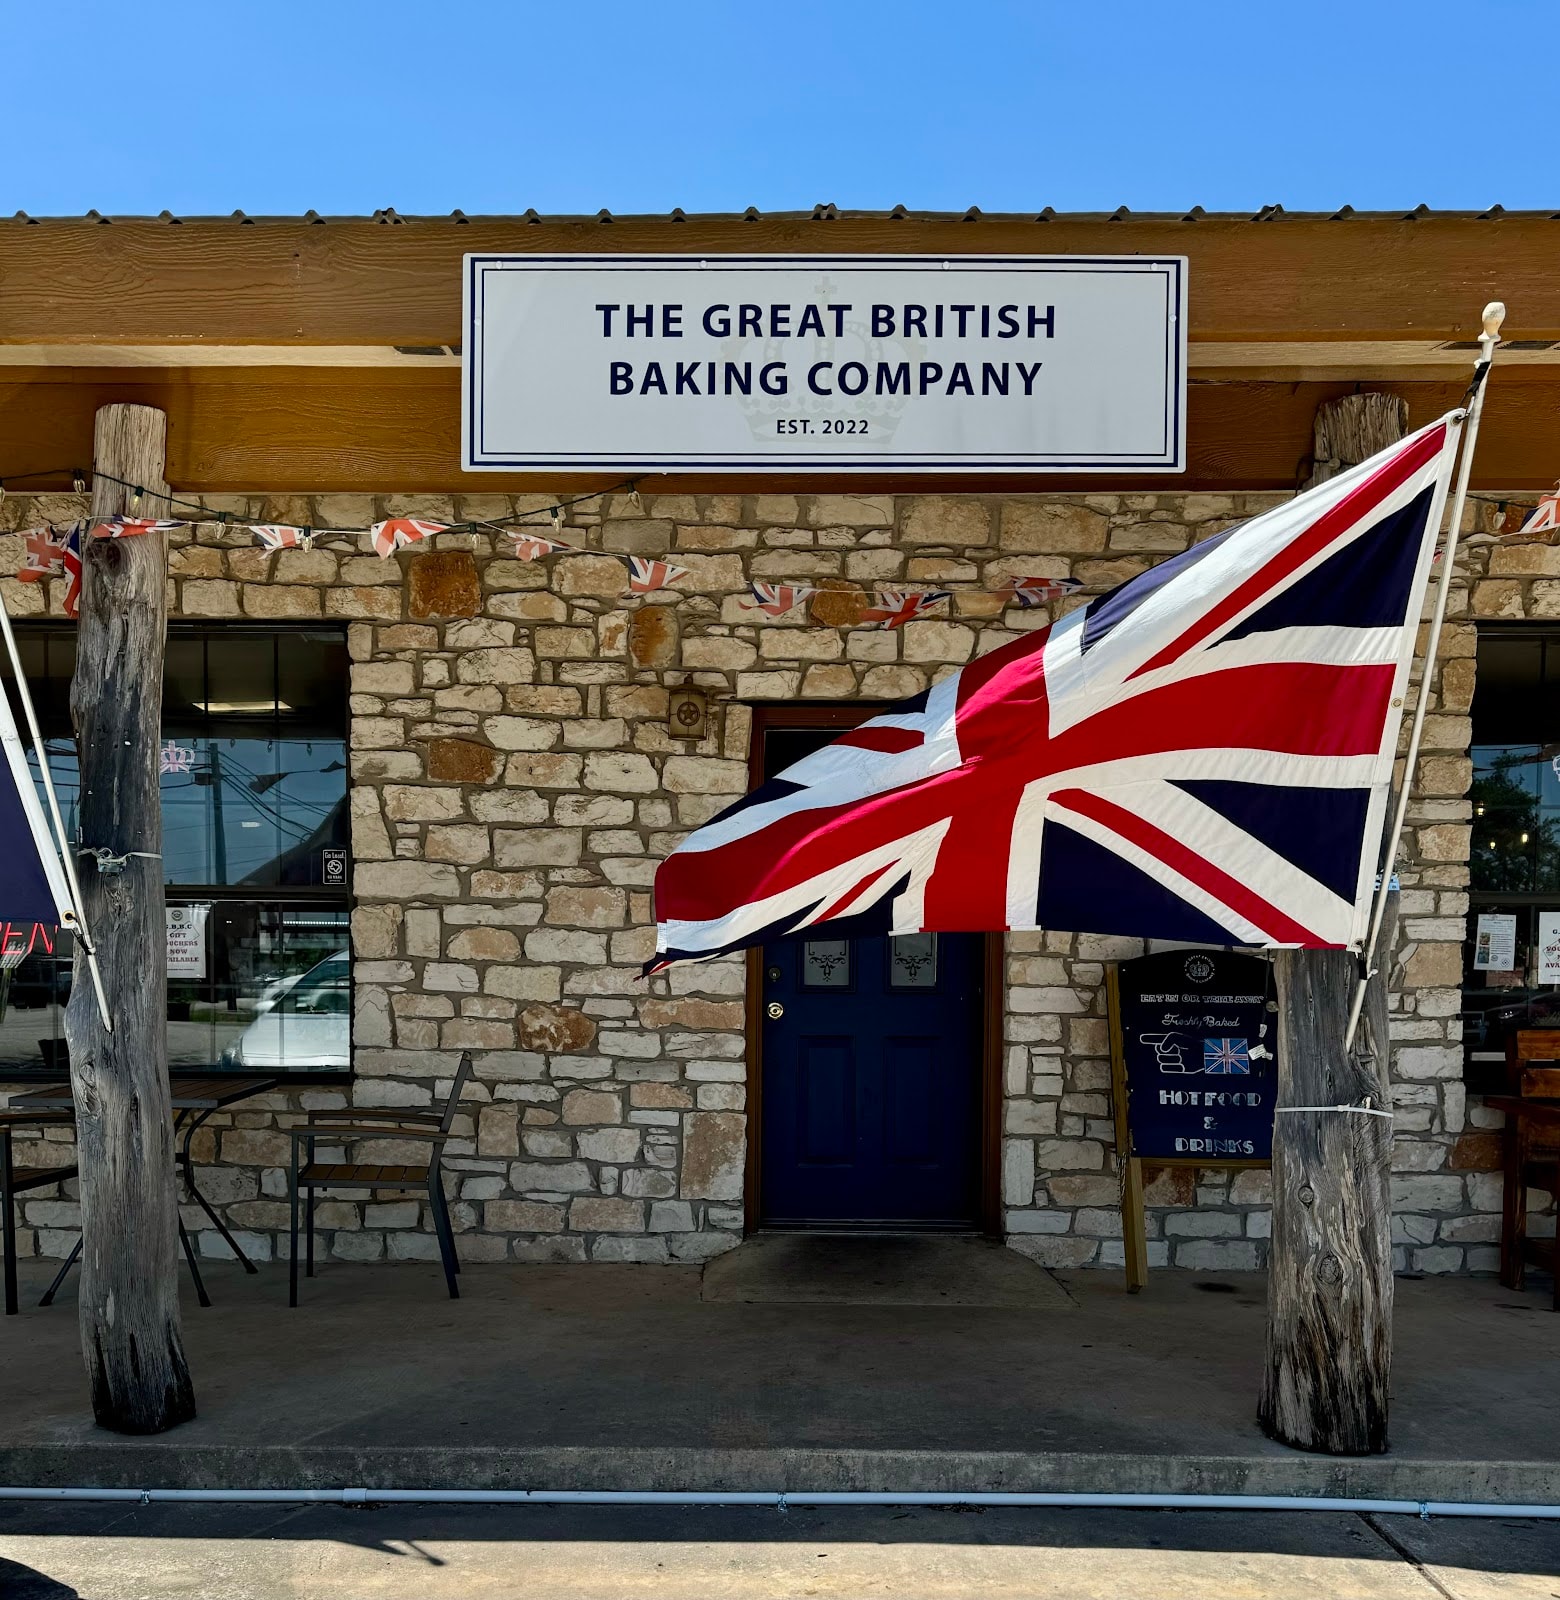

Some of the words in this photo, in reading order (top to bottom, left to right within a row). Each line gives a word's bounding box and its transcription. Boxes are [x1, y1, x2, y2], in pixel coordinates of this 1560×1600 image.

[595, 303, 684, 338] THE
[702, 303, 853, 338] GREAT
[871, 303, 1055, 339] BRITISH
[609, 361, 789, 396] BAKING
[807, 361, 1043, 396] COMPANY
[776, 418, 815, 435] EST.
[822, 418, 869, 435] 2022
[1182, 993, 1200, 1003] OR
[1161, 1012, 1202, 1029] Freshly
[1203, 1015, 1241, 1028] Baked
[1159, 1089, 1201, 1106] HOT
[1204, 1091, 1261, 1107] FOOD
[1203, 1116, 1218, 1130] &
[1175, 1137, 1254, 1154] DRINKS
